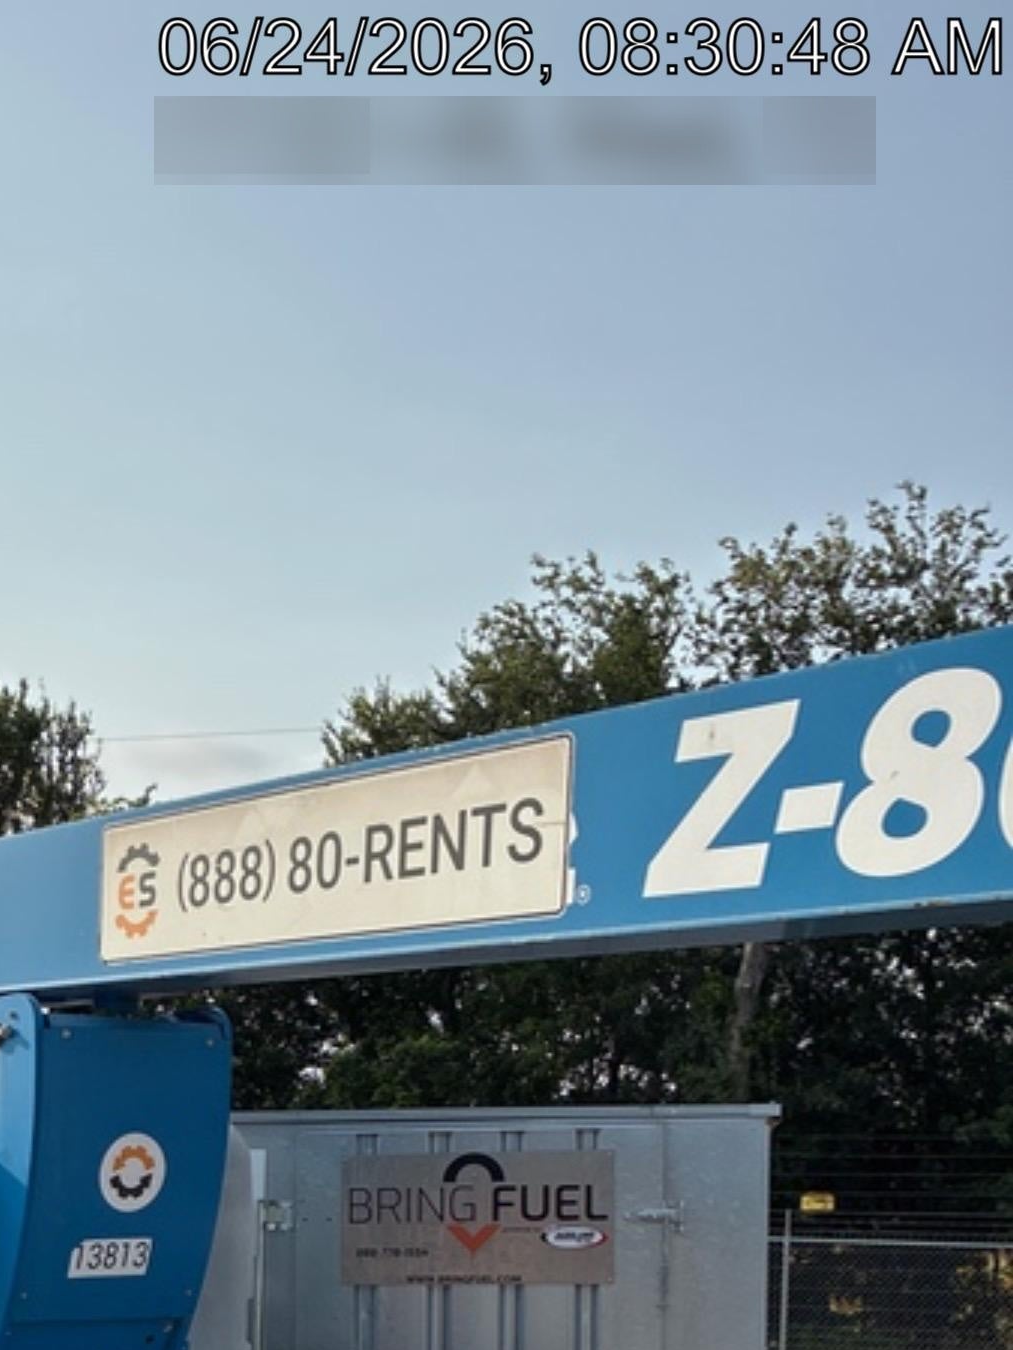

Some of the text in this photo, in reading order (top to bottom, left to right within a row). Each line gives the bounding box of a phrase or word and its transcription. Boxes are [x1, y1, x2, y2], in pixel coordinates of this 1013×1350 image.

[642, 667, 1013, 898] Z-8
[178, 797, 544, 912] (888) 80-RENTS
[348, 1184, 609, 1224] BRING FUEL
[75, 1241, 149, 1270] 13813
